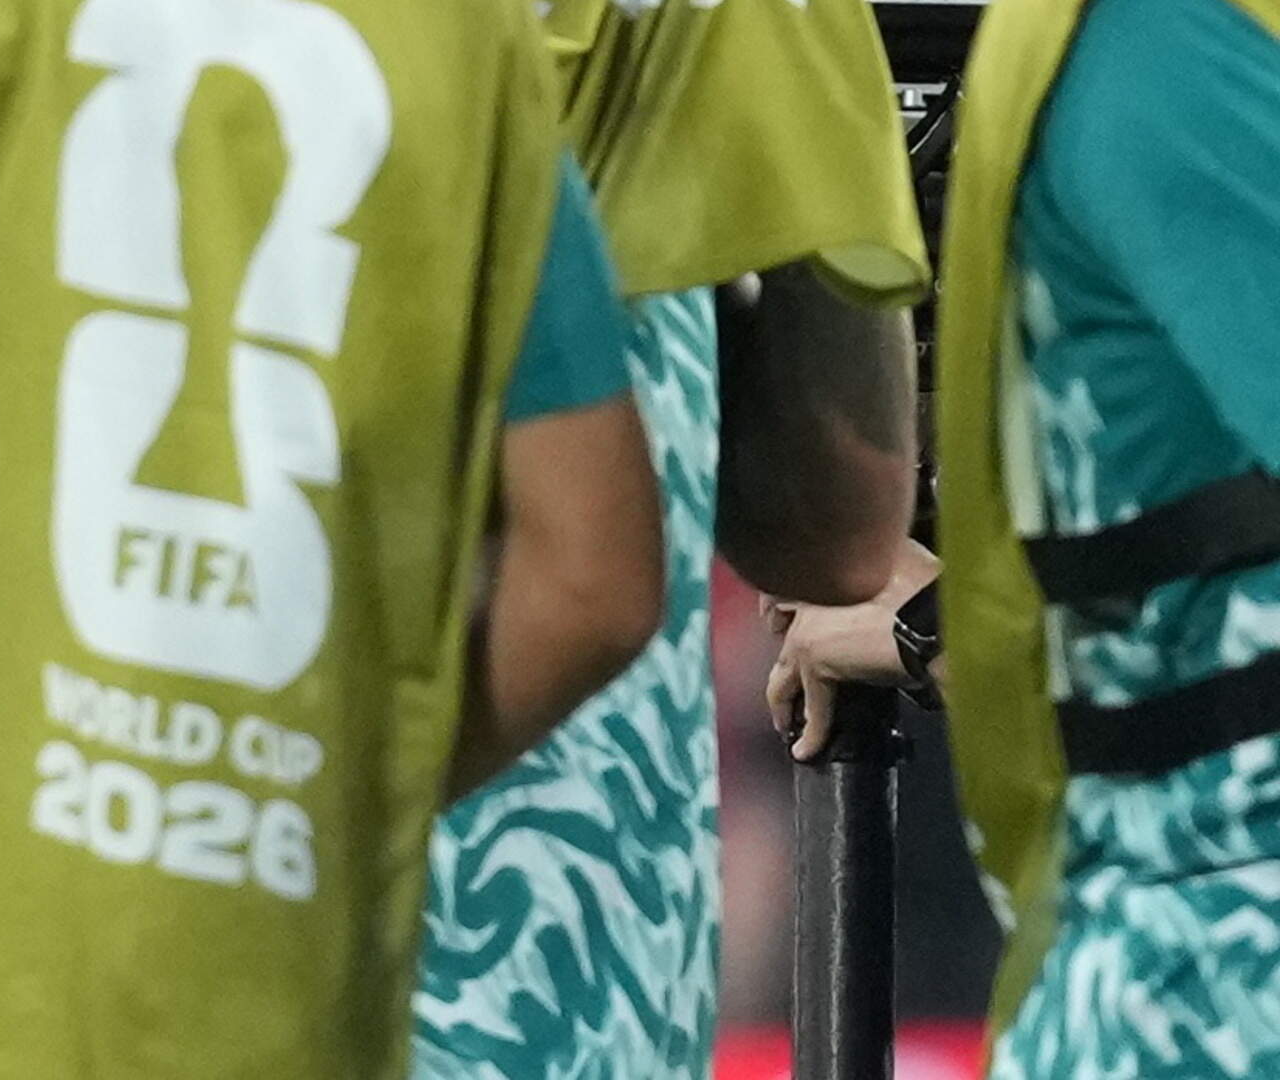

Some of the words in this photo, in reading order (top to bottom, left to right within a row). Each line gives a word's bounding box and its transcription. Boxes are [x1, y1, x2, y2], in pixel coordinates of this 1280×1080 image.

[112, 525, 259, 614] FIFA
[42, 661, 224, 766] WORLD
[231, 716, 323, 787] CUP
[32, 739, 317, 902] 2026
